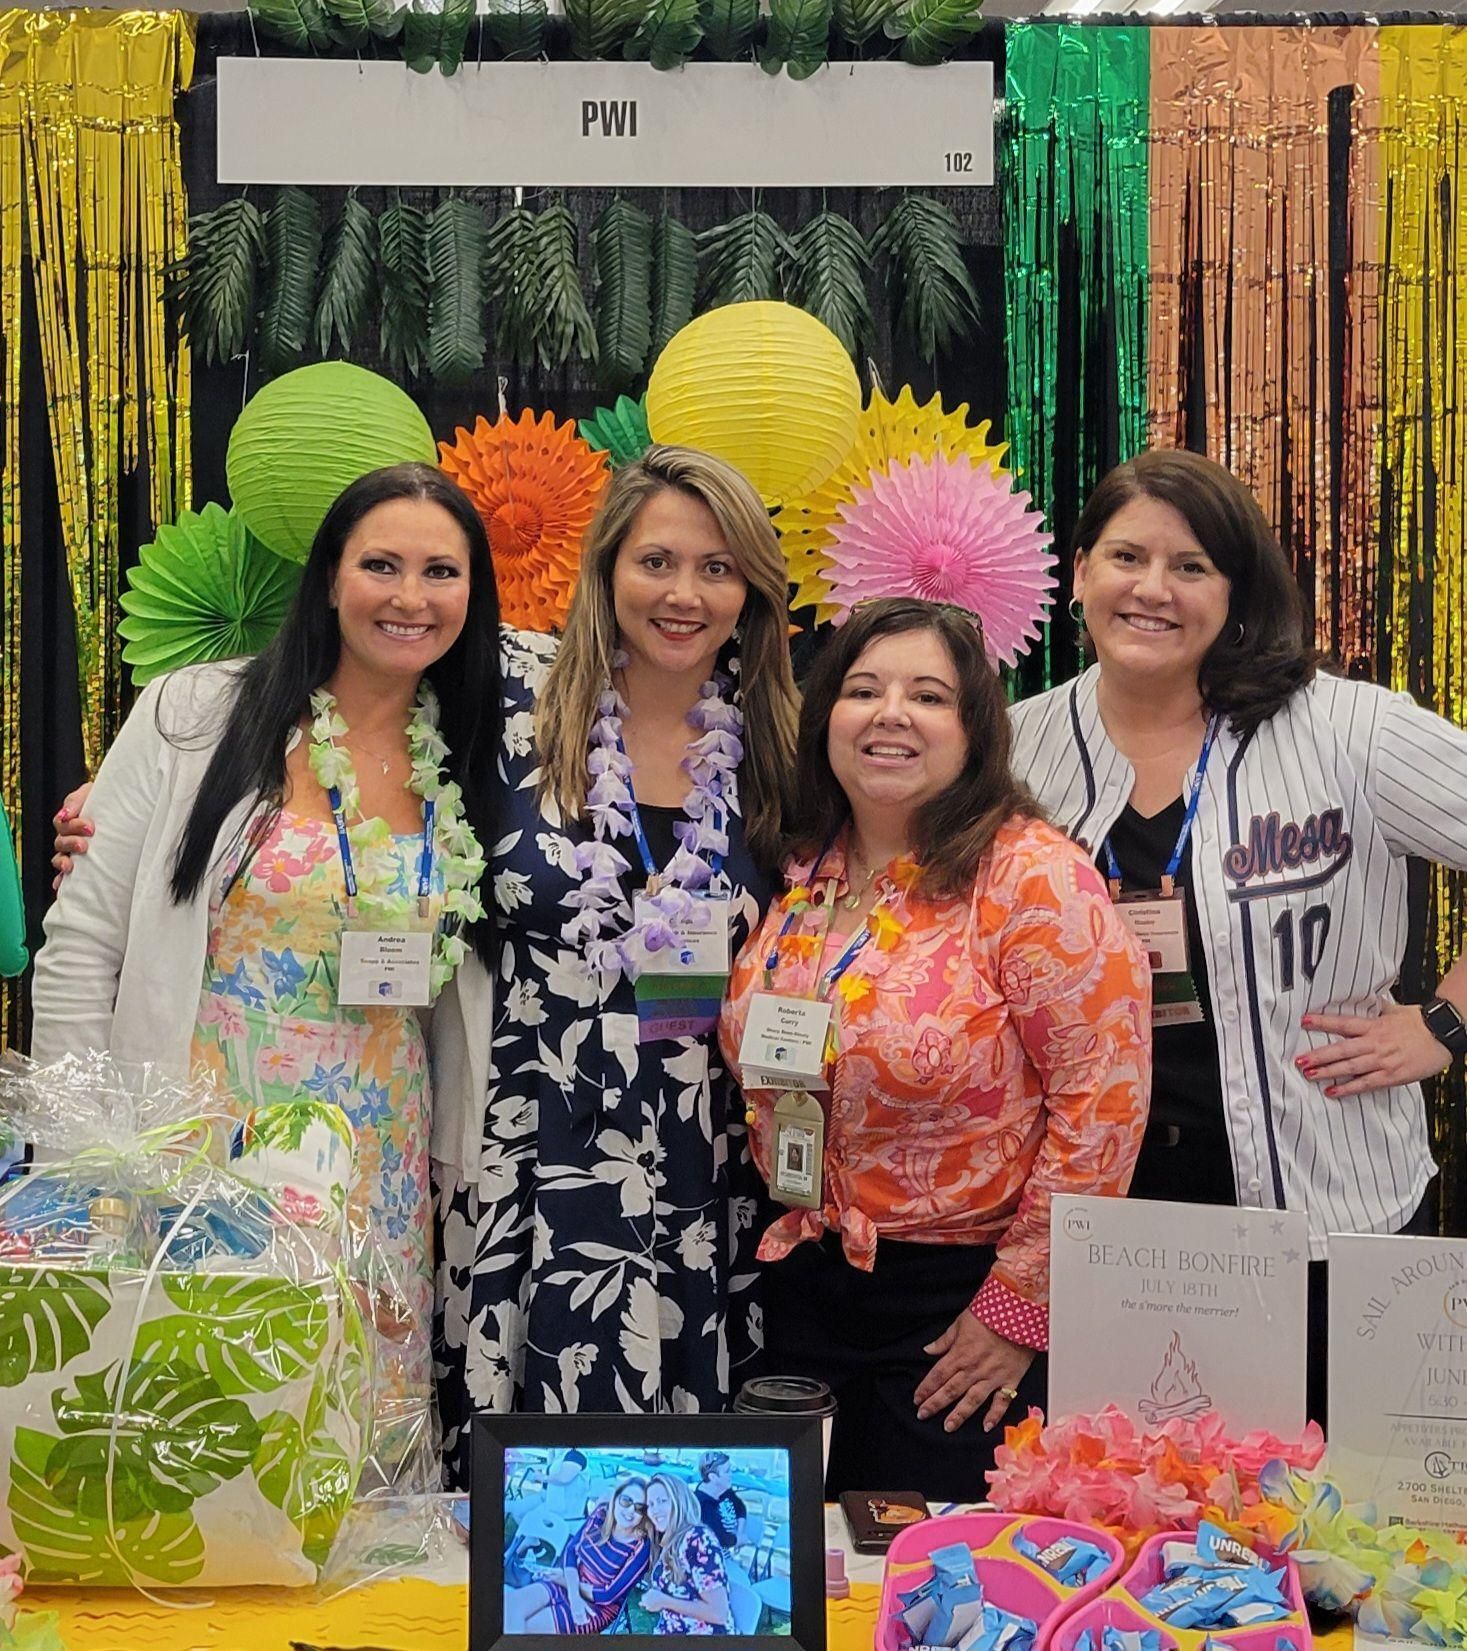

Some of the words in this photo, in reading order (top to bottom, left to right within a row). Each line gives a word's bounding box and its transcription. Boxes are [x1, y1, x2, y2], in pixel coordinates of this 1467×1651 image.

[581, 100, 638, 137] PWI
[943, 152, 973, 173] 102
[1223, 807, 1345, 883] Mesa
[377, 935, 406, 944] Andrea
[1272, 902, 1332, 993] 10
[777, 1006, 806, 1017] Roberta
[648, 1019, 695, 1034] GUEST
[780, 1017, 800, 1027] Curry
[1068, 1219, 1090, 1231] PWI
[1088, 1243, 1167, 1270] BEACH
[1178, 1250, 1277, 1278] BONFIRE
[1140, 1278, 1177, 1295] JULY
[1182, 1282, 1219, 1298] 18TH
[1356, 1296, 1392, 1341] SAIL
[1390, 1251, 1464, 1295] AROUN
[1121, 1298, 1137, 1310] the
[1138, 1301, 1174, 1313] s'more
[1175, 1303, 1193, 1315] the
[1194, 1306, 1239, 1318] merrier!
[1397, 1480, 1428, 1493] 2700
[1410, 1494, 1430, 1504] SAN
[1432, 1496, 1467, 1508] DIEGO,
